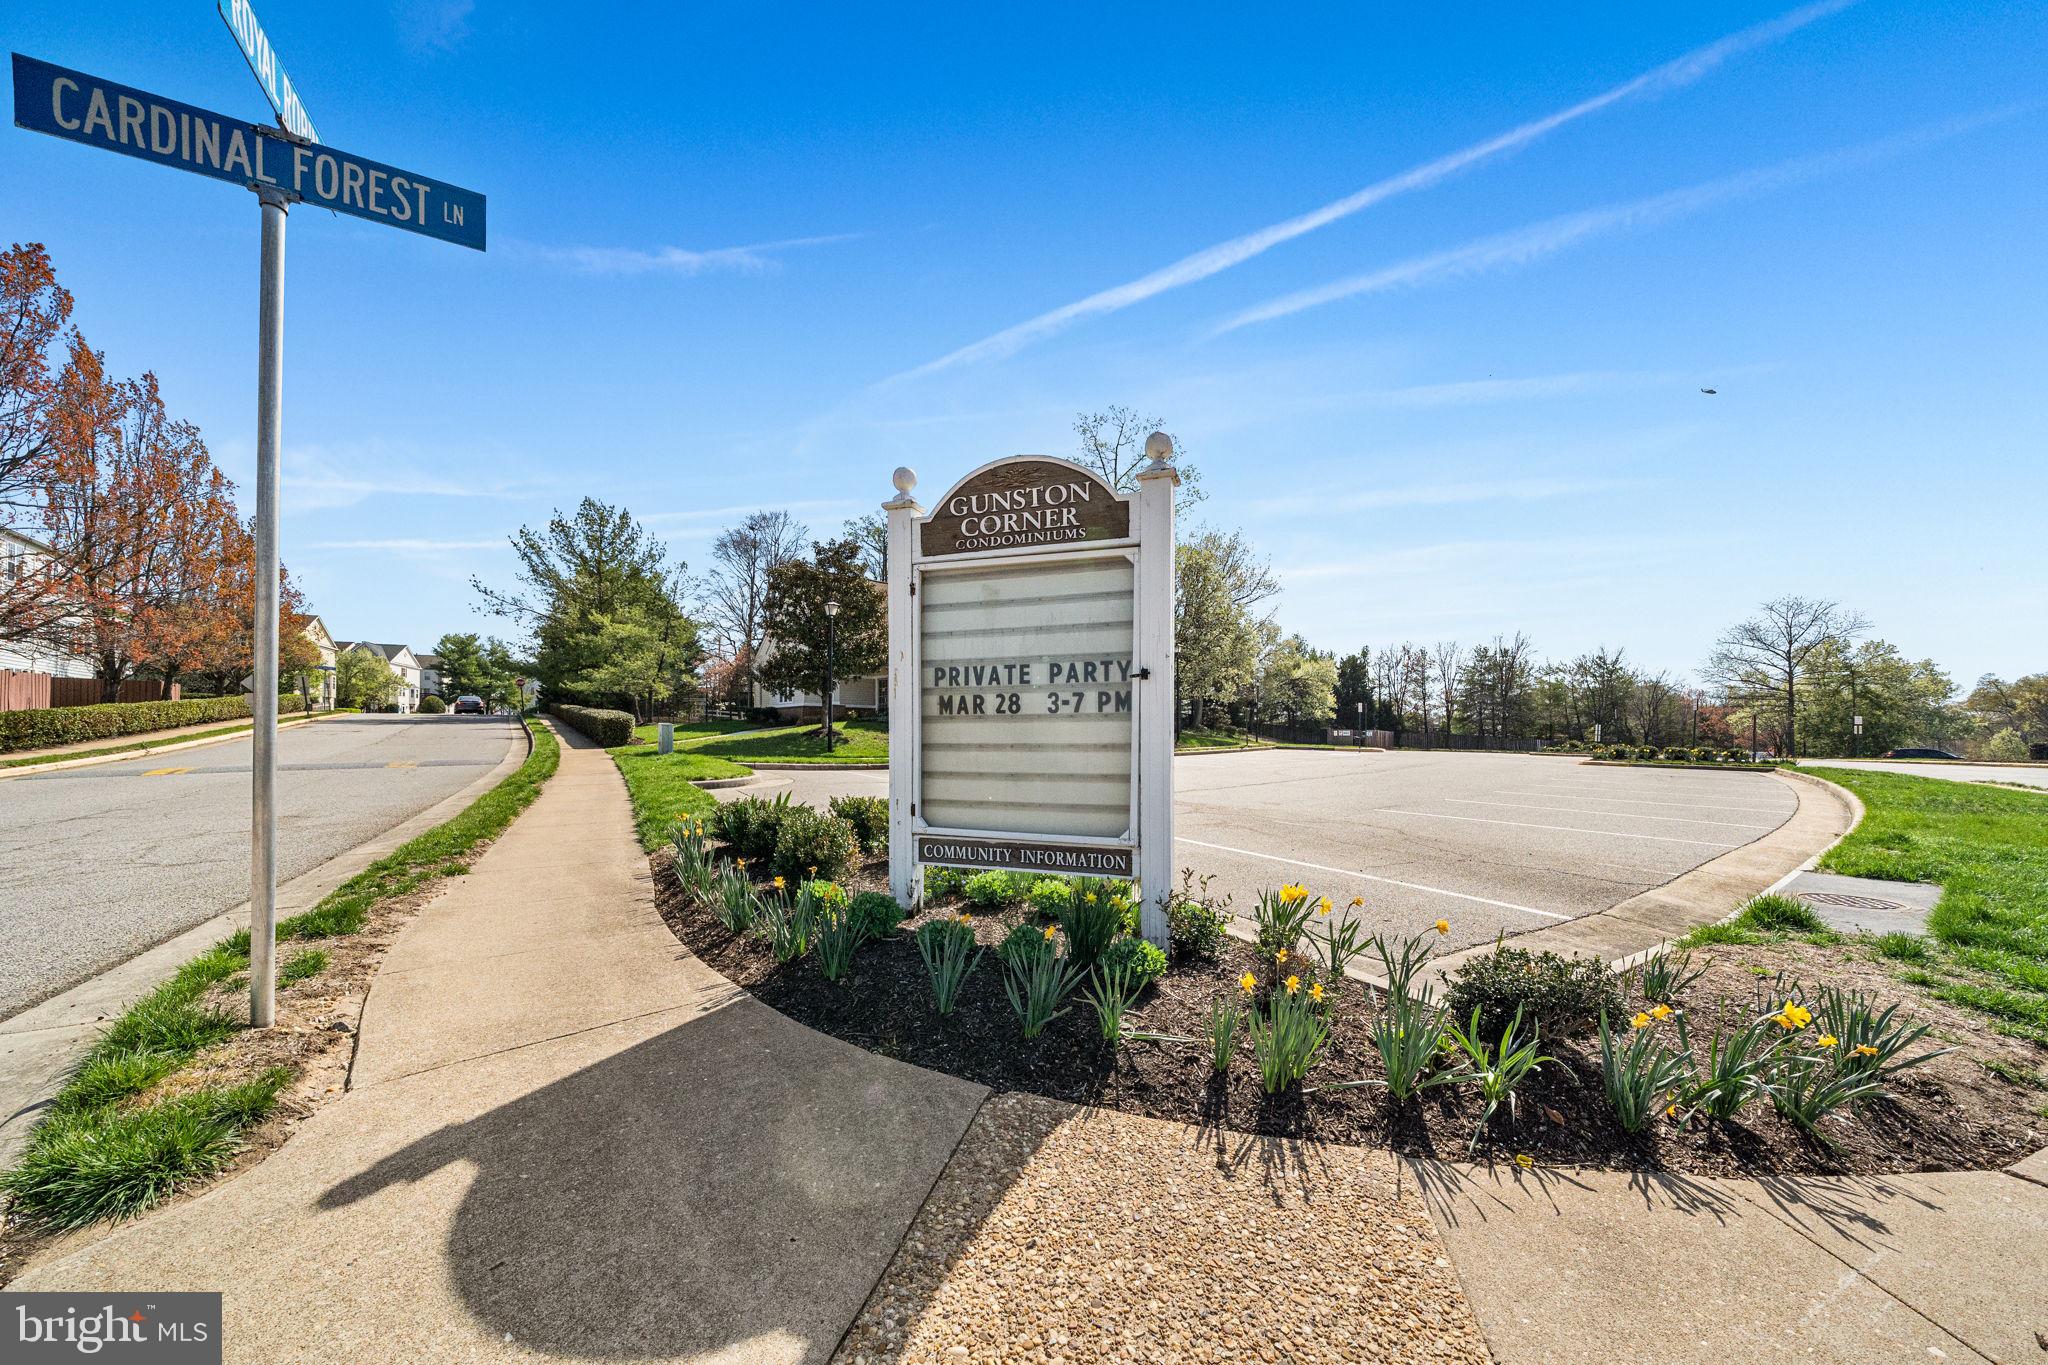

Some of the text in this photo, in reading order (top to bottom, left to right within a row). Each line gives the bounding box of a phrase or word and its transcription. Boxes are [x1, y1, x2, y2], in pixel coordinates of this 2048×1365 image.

[231, 0, 281, 108] ROYAL
[52, 77, 464, 228] CARDINAL FOREST LN
[949, 481, 1092, 516] GUNSTON
[960, 507, 1081, 537] CORNER
[955, 527, 1087, 550] CONDOMINIUMS
[934, 659, 1132, 687] PRIVATE PARTY
[938, 691, 1132, 715] MAR 28 3-7 PM
[924, 844, 1127, 870] COMMUNITY INFORMATION
